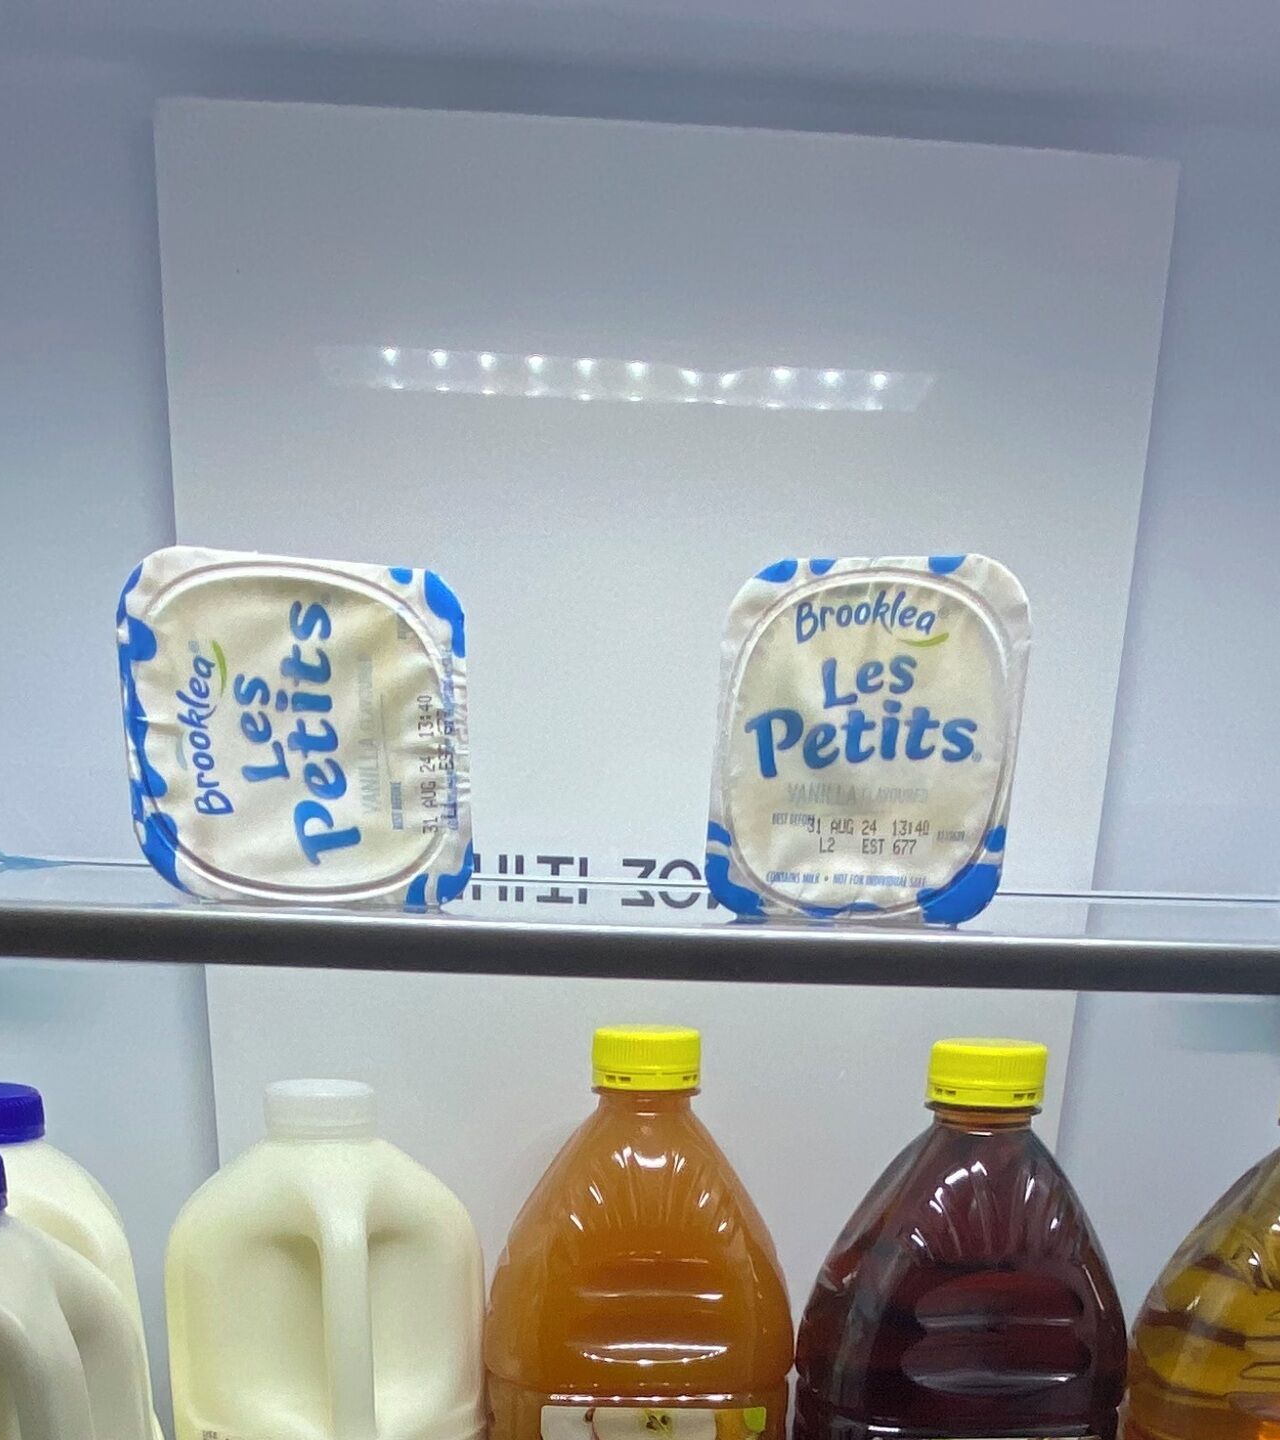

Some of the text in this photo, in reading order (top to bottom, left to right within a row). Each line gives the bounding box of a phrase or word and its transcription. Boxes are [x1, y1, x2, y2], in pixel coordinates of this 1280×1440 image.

[795, 590, 937, 644] Brooklea
[821, 654, 918, 709] Les
[176, 657, 233, 815] Brooklea
[233, 673, 290, 783] Les
[276, 600, 362, 865] Petits
[417, 695, 439, 833] 31 AUG 24 13:40
[745, 700, 978, 778] Petits
[819, 838, 917, 855] L2 EST 677
[830, 820, 854, 835] AUG
[861, 820, 877, 835] 24
